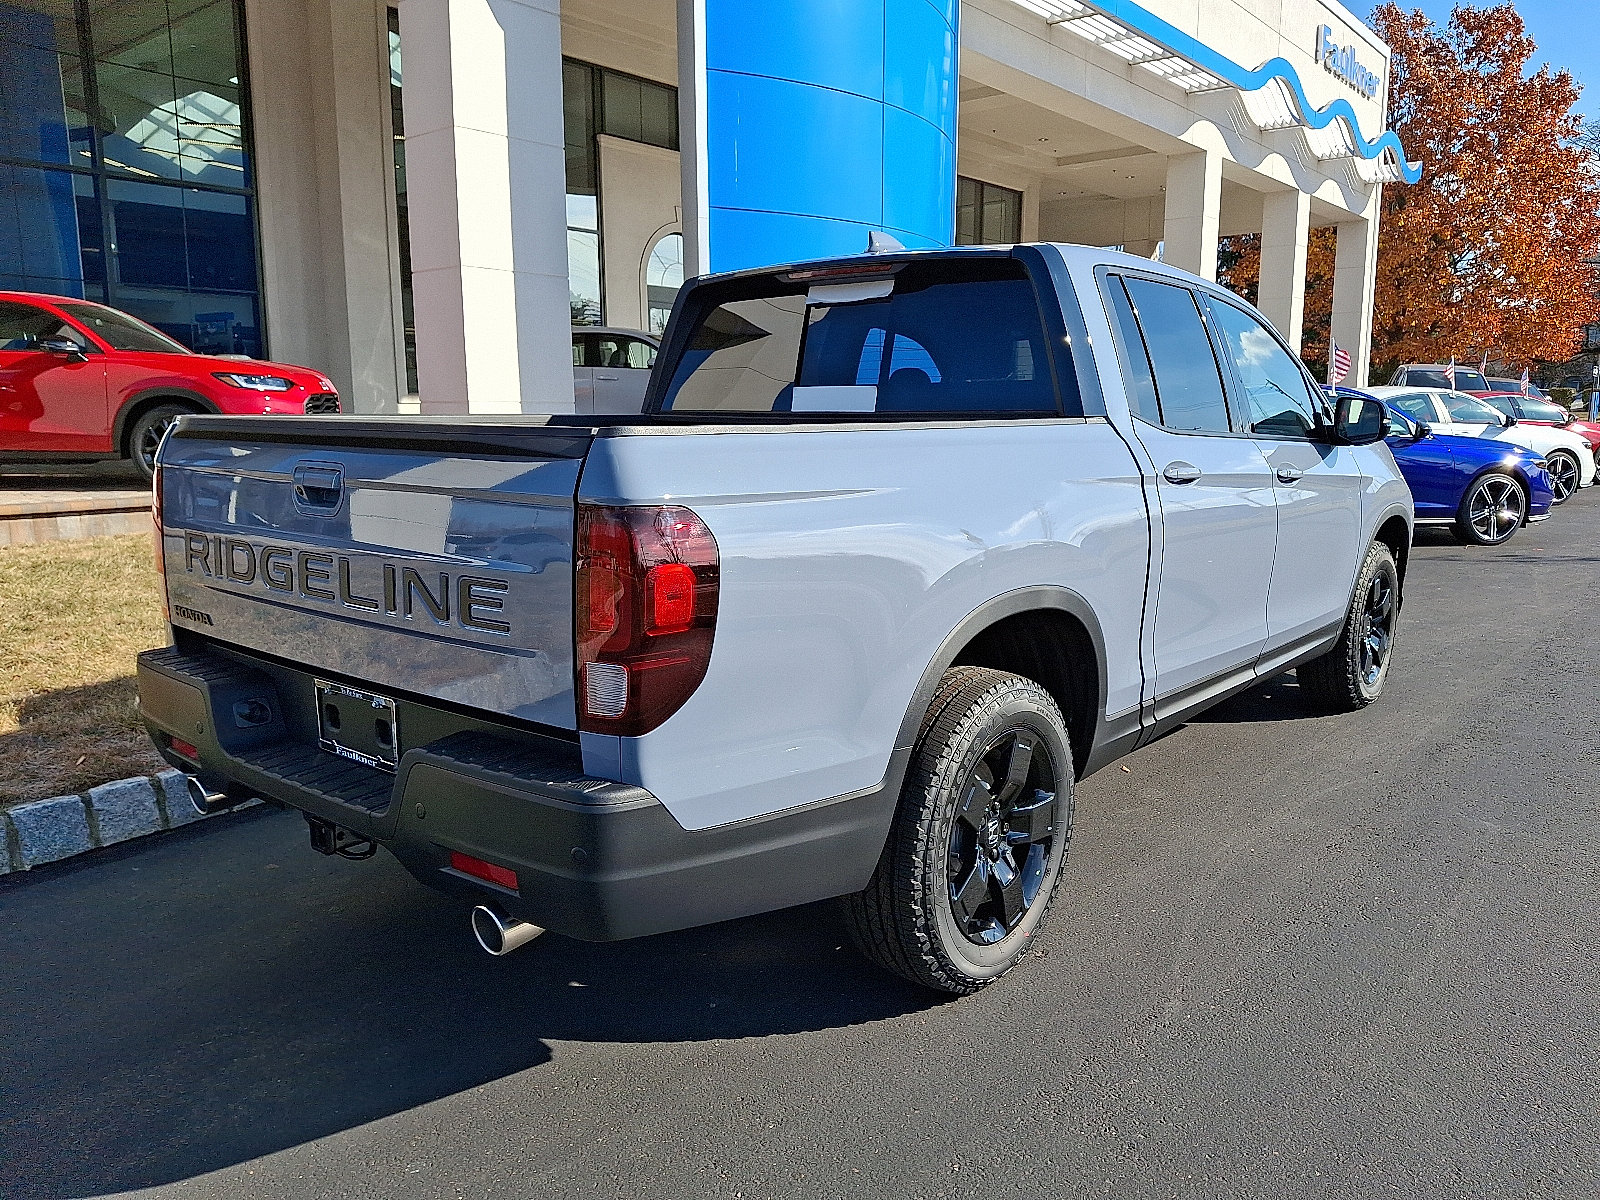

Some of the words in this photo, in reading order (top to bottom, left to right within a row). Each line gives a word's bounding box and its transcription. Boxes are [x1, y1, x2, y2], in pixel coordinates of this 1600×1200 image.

[1315, 24, 1380, 98] Faulkner
[184, 530, 511, 636] RIDGELINE
[174, 604, 214, 626] HONDA
[335, 746, 378, 767] Faulkner
